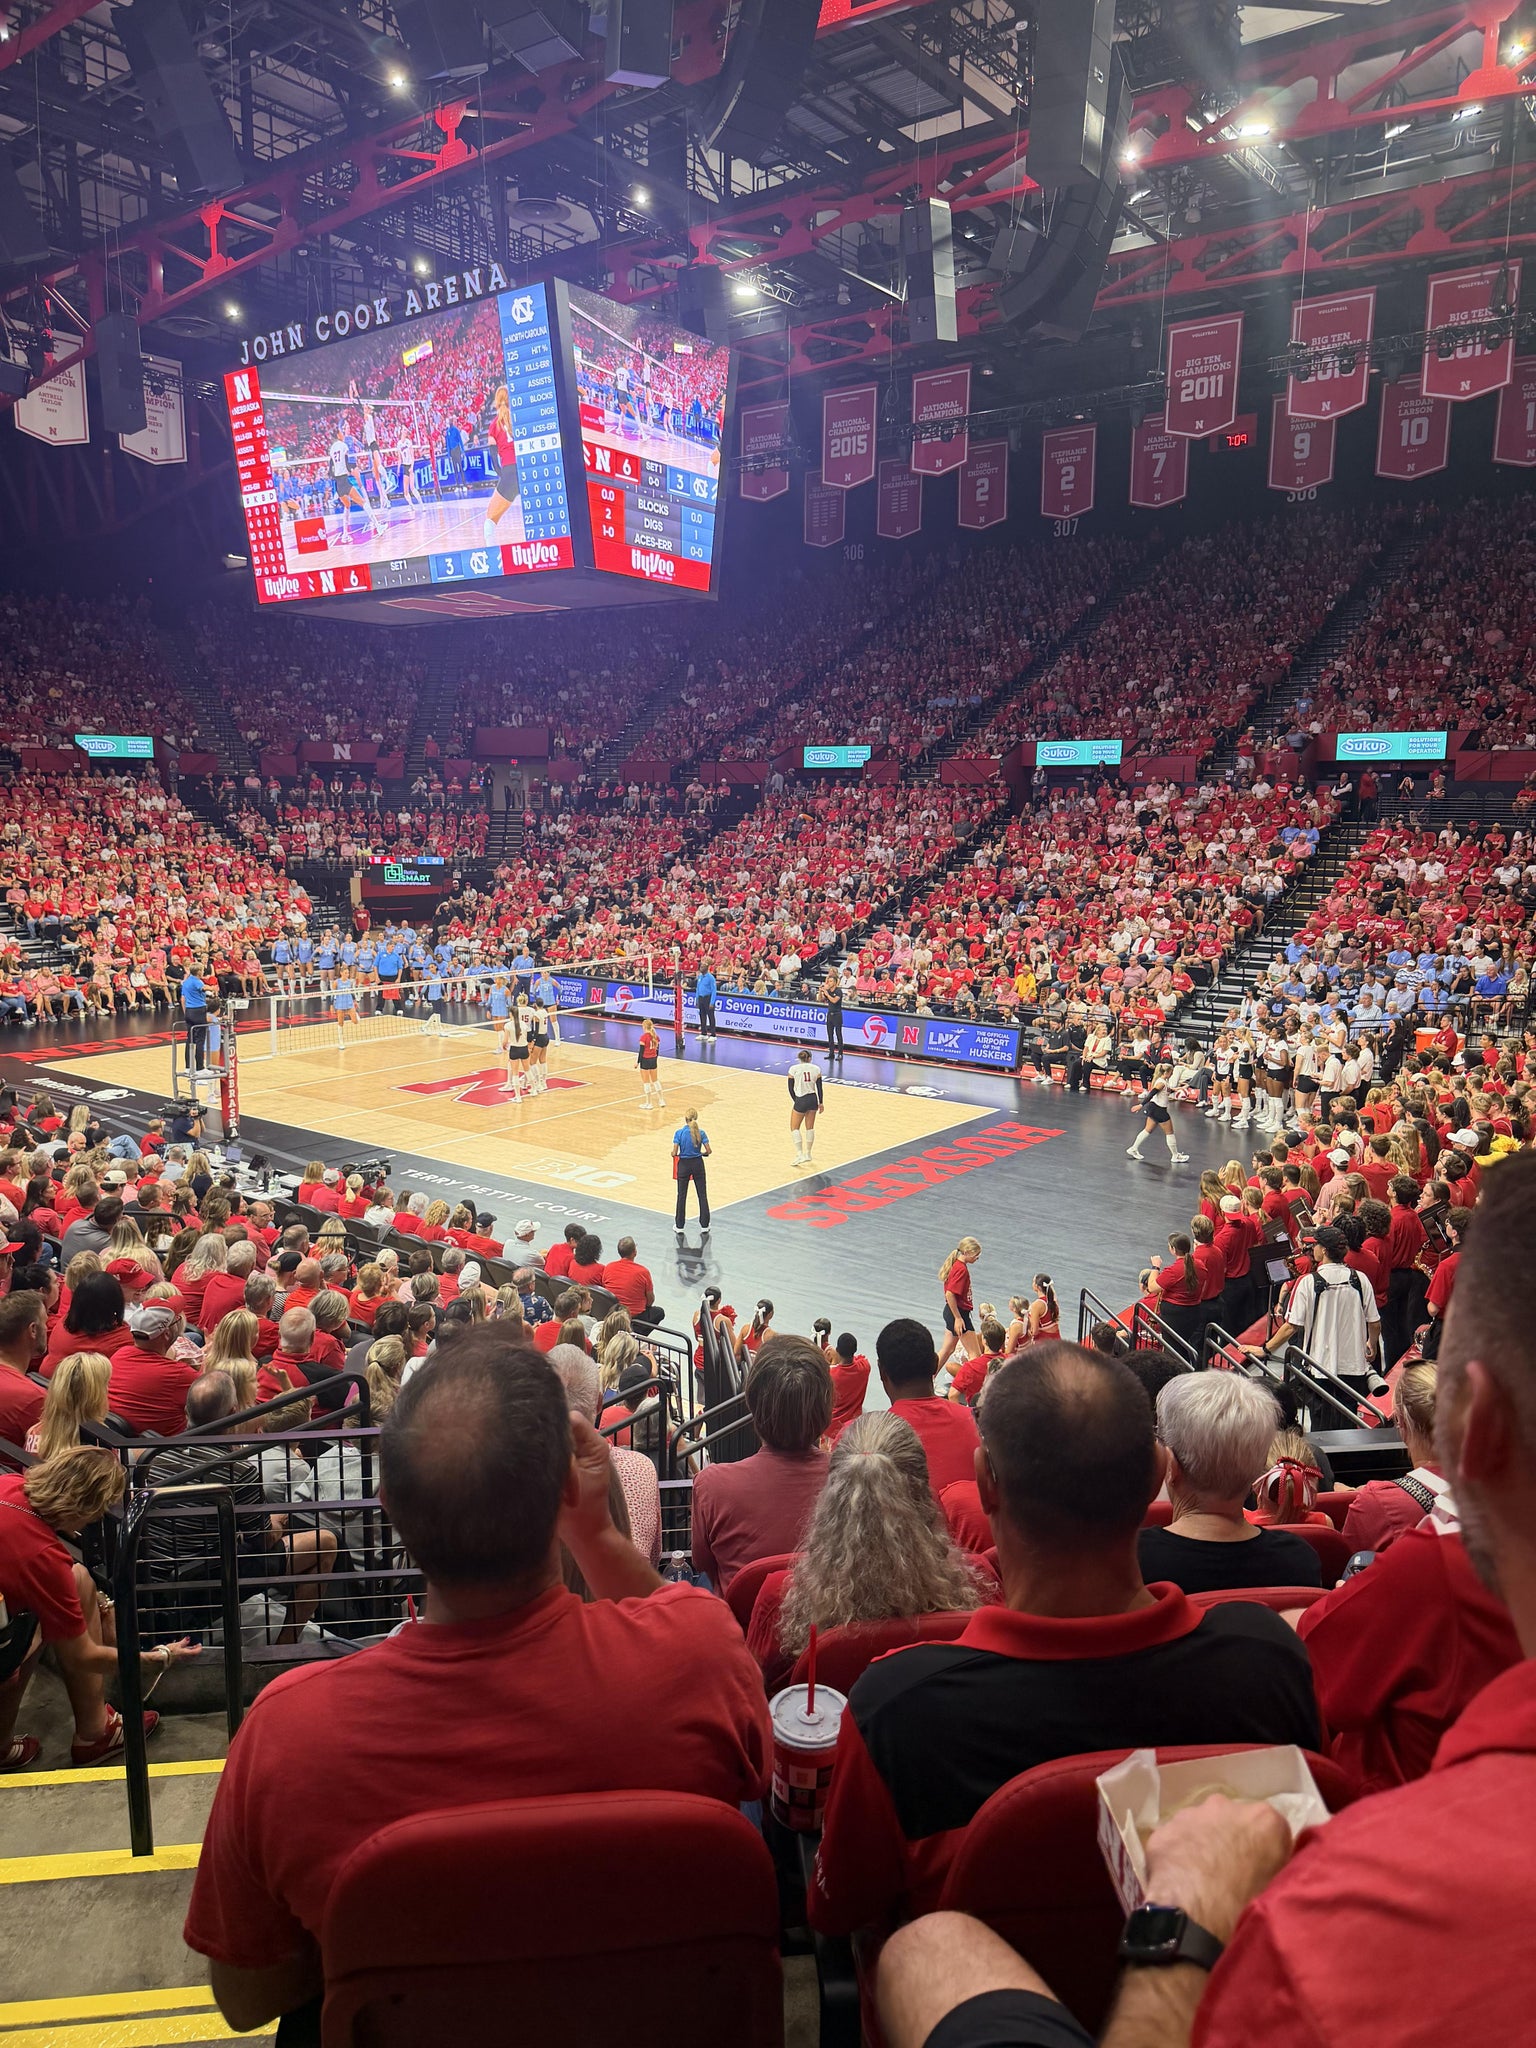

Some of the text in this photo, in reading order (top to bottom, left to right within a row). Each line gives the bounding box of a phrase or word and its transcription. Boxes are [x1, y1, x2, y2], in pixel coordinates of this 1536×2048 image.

[241, 263, 506, 365] JOHN COOK ARENA
[1449, 311, 1468, 322] BIG
[509, 330, 524, 343] NORTH
[524, 325, 548, 340] CAROLINA
[1312, 336, 1328, 346] BIG
[1331, 332, 1351, 342] TEN
[532, 345, 541, 355] HIT
[1186, 354, 1222, 368] BIG TEN
[508, 360, 550, 377] 3-2 KILLS-ERR
[1175, 361, 1232, 378] CHAMPIONS
[234, 374, 251, 402] N
[510, 376, 552, 392] 3 ASSISTS
[1180, 374, 1223, 403] 2011
[1460, 380, 1471, 391] N
[512, 392, 553, 407] 0.0 BLOCKS
[923, 400, 959, 413] NATIONAL
[1322, 401, 1331, 411] N
[1398, 399, 1434, 408] JORDAN
[513, 407, 555, 422] 1 DIGS
[919, 407, 963, 421] CHAMPIONS
[1398, 406, 1434, 416] LARSON
[832, 417, 866, 428] NATIONAL
[1195, 420, 1204, 429] N
[1290, 422, 1317, 431] PAVAN
[49, 426, 57, 436] N
[515, 422, 556, 438] 0-0 ACES-ERR
[829, 424, 870, 436] CHAMPIONS
[1400, 417, 1429, 446] 10
[530, 441, 535, 450] K
[540, 439, 545, 448] B
[552, 437, 557, 446] D
[750, 433, 781, 443] NATIONAL
[1226, 434, 1247, 446] 7:09
[151, 446, 158, 455] N
[830, 434, 868, 458] 2015
[1144, 442, 1176, 452] METCALF
[1294, 432, 1311, 459] 9
[521, 452, 558, 466] 1 0 0 1
[595, 447, 610, 473] N
[1051, 448, 1087, 458] STEPHANIE
[623, 459, 631, 475] 6
[646, 461, 662, 473] SET 1
[936, 459, 942, 468] N
[1152, 452, 1166, 478] 7
[1407, 463, 1415, 471] N
[415, 464, 434, 490] THE
[469, 456, 482, 467] WE
[522, 466, 560, 481] 3 0 0 0
[845, 473, 851, 482] N
[1061, 466, 1075, 490] 2
[1296, 476, 1304, 484] N
[265, 480, 274, 488] 1-0
[523, 480, 562, 495] 6 0 0 0
[649, 476, 659, 486] 0-0
[677, 474, 684, 490] 3
[976, 478, 989, 501] 2
[524, 495, 563, 510] 10 0 0 0
[601, 488, 702, 524] 0.0 BLOCKS 0.0
[525, 510, 565, 524] 22 1 0 0
[606, 508, 697, 539] 2 DIGS 1
[526, 525, 566, 539] 77 2 0 0
[1054, 518, 1079, 537] 307
[603, 525, 702, 558] 1-0 ACES-ERR 0-0
[843, 544, 864, 560] 306
[390, 560, 404, 571] SET
[445, 558, 454, 574] 3
[320, 570, 336, 593] N
[350, 571, 358, 587] 6
[82, 739, 113, 753] Sukup
[333, 744, 351, 760] N
[1043, 746, 1075, 759] Sukup
[1346, 739, 1387, 753] Sukup
[809, 751, 835, 762] Sukup
[1375, 941, 1382, 949] N
[591, 987, 603, 1003] N
[726, 999, 760, 1014] Seven
[522, 1015, 529, 1023] 15
[725, 1019, 752, 1029] Breeze
[773, 1024, 805, 1034] UNITED
[902, 1026, 919, 1045] N
[928, 1031, 960, 1048] LNK
[976, 1036, 1010, 1047] AIRPORT
[969, 1048, 1012, 1061] HUSKERS
[803, 1071, 811, 1082] 11
[766, 1121, 1067, 1229] HUSKERS
[400, 1168, 612, 1223] TERRY PETTIT COURT
